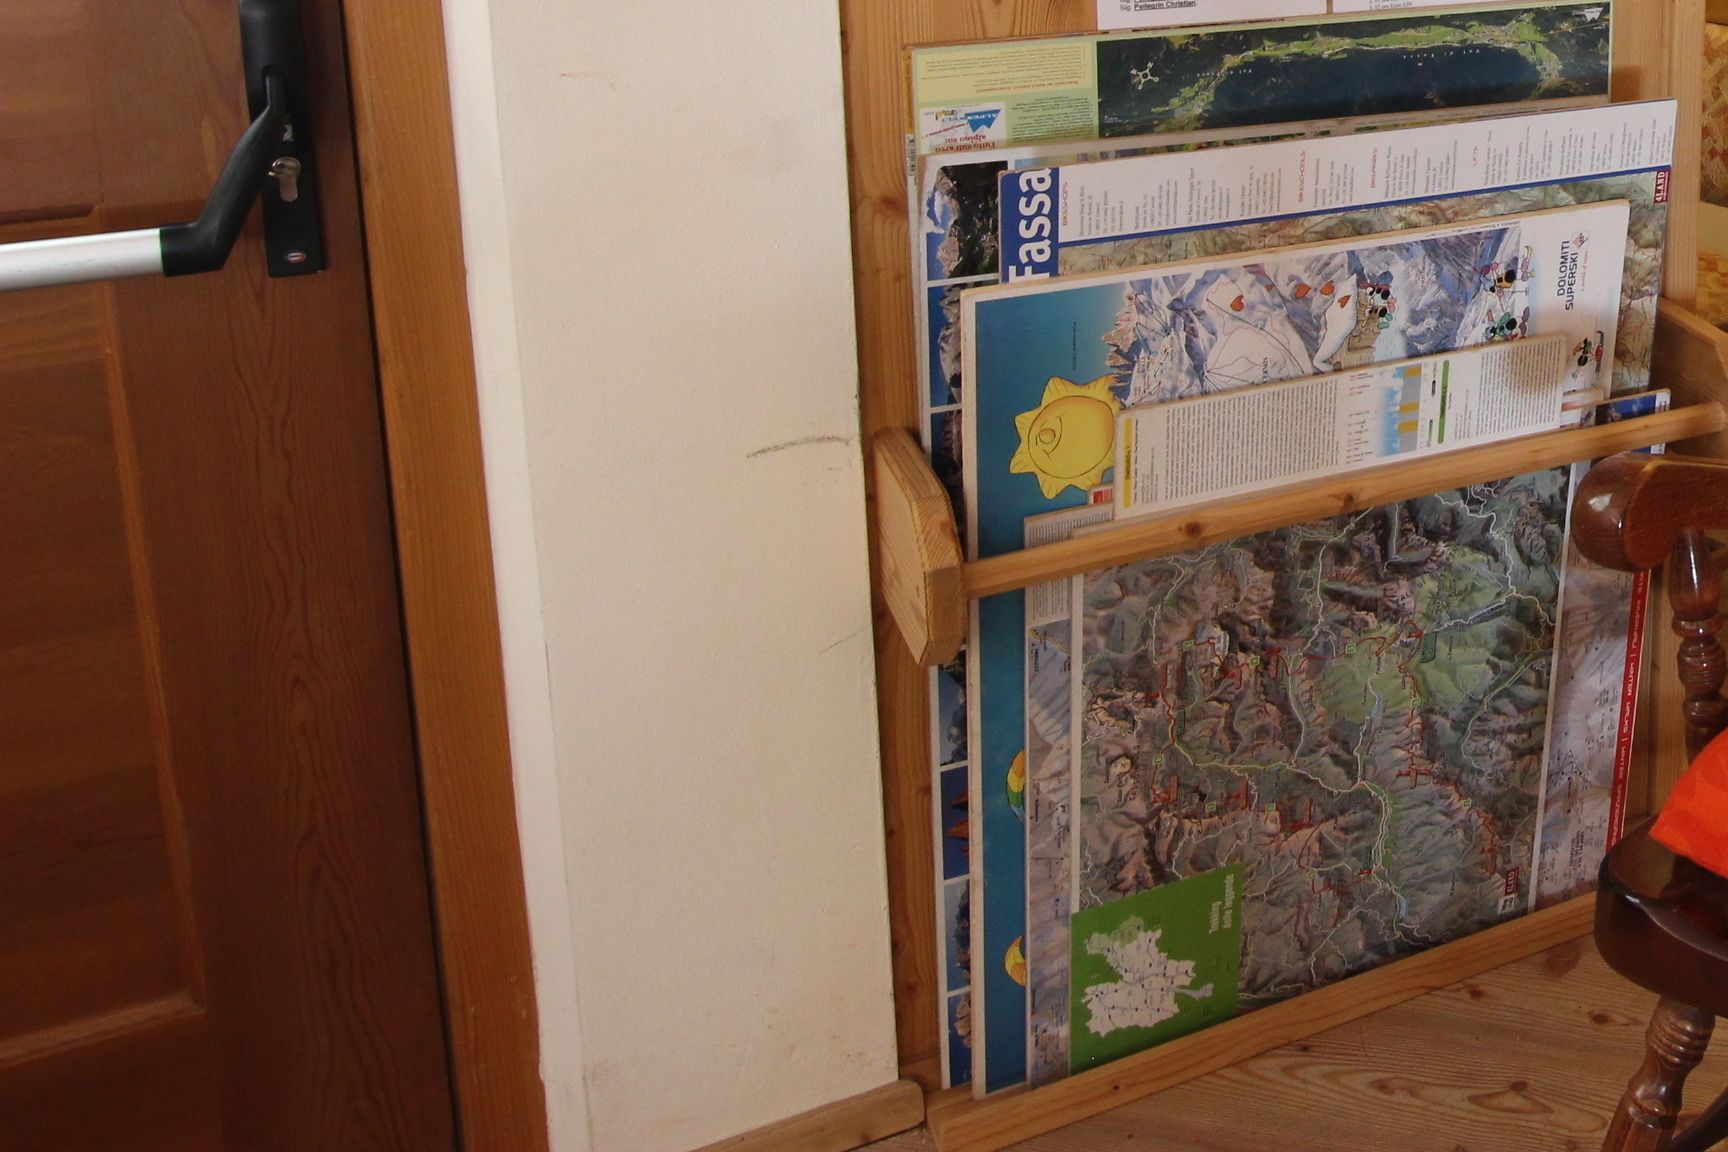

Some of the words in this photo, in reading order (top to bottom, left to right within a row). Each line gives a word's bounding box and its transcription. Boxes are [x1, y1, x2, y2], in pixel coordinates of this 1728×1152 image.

[1655, 170, 1667, 203] 4LAND
[1556, 239, 1571, 297] DOLOMITI
[1564, 251, 1579, 311] SUPERSKI
